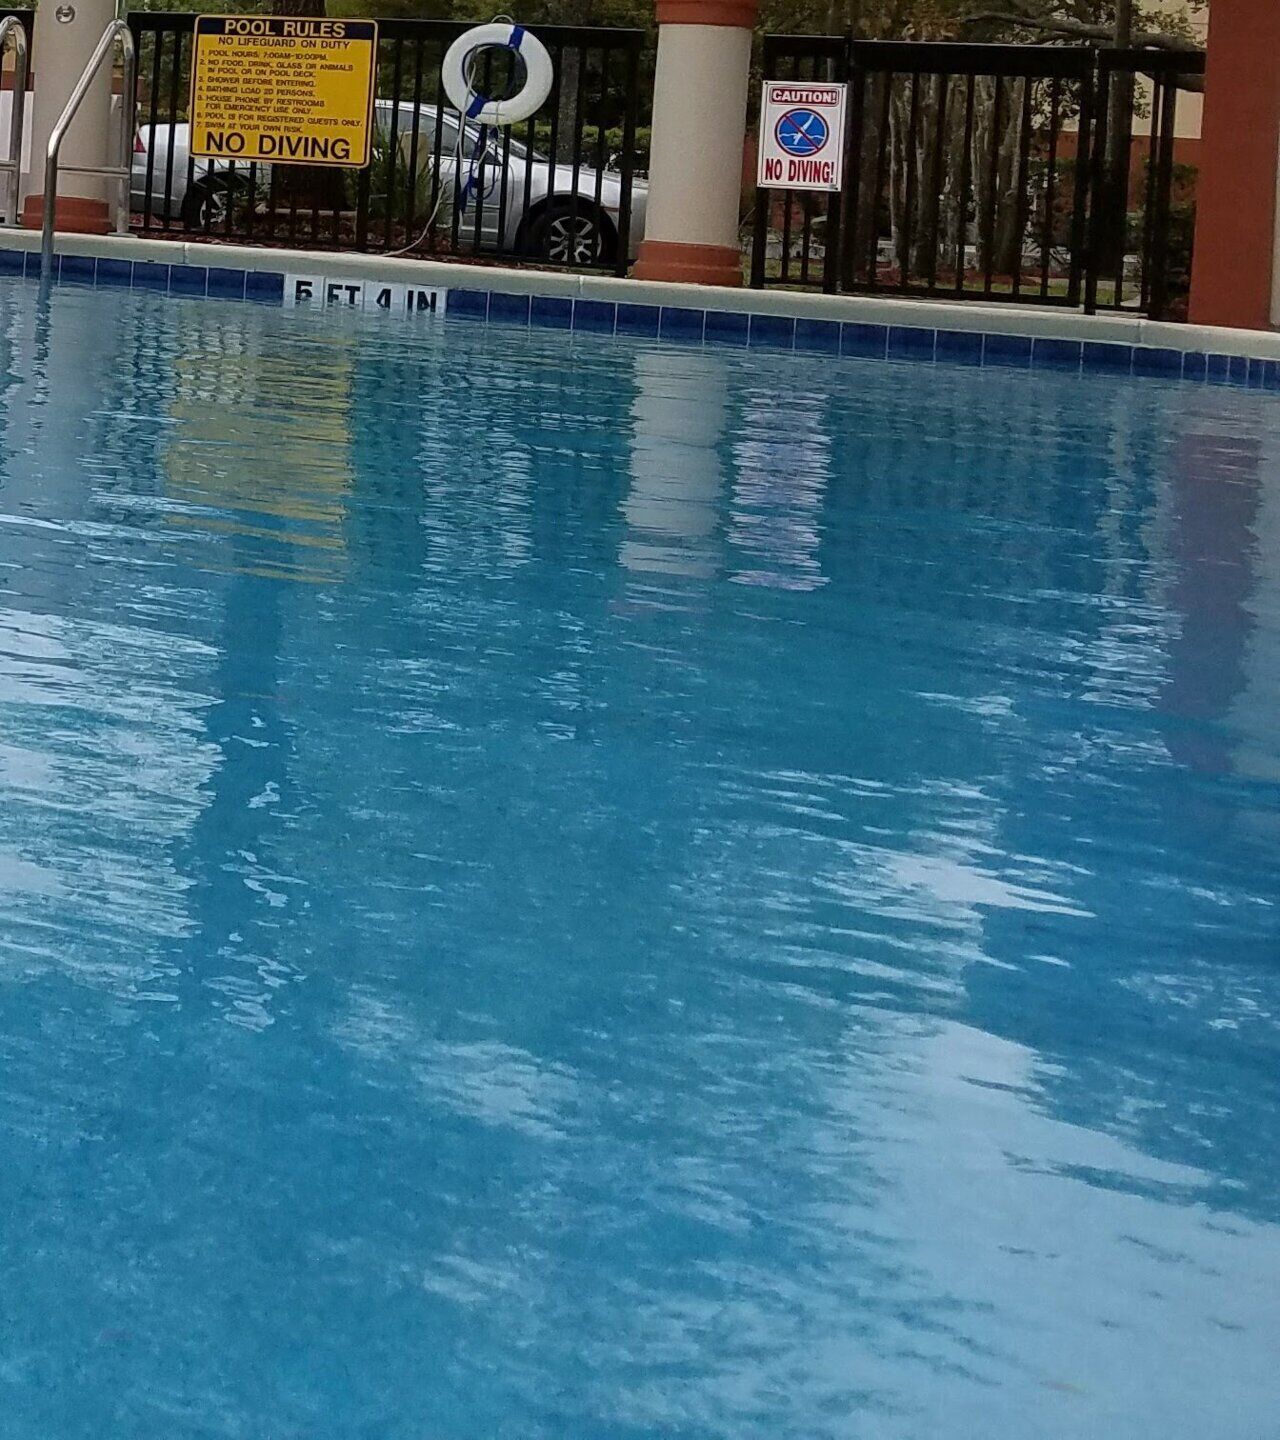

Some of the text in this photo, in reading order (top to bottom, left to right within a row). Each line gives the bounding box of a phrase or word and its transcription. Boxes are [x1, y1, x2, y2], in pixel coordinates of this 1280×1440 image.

[224, 19, 346, 38] POOL RULES
[218, 36, 350, 50] NO LIFEGUARD ON DUTY
[208, 49, 229, 57] POOL
[217, 67, 238, 75] POOL
[276, 61, 303, 70] GLASS
[305, 62, 317, 70] OR
[320, 63, 354, 71] ANIMALS
[207, 76, 240, 84] SHOWER
[242, 77, 273, 85] BEFORE
[206, 85, 238, 93] BATHING
[240, 87, 261, 95] LOAD
[772, 89, 837, 103] CAUTION!
[205, 102, 221, 110] FOR
[223, 103, 271, 112] EMERGENCY
[206, 94, 232, 102] HOUSE
[235, 95, 260, 104] PHONE
[263, 97, 274, 105] BY
[276, 98, 325, 107] RESTROOMS
[205, 112, 226, 120] POOL
[238, 113, 254, 121] FOR
[256, 114, 305, 124] REGISTERED
[307, 117, 338, 126] GUESTS
[204, 121, 226, 129] SWIM
[240, 123, 260, 131] YOUR
[205, 131, 350, 159] NO DIVING
[765, 158, 834, 183] NO DIVING!
[295, 280, 437, 312] 5 FT 4 IN
